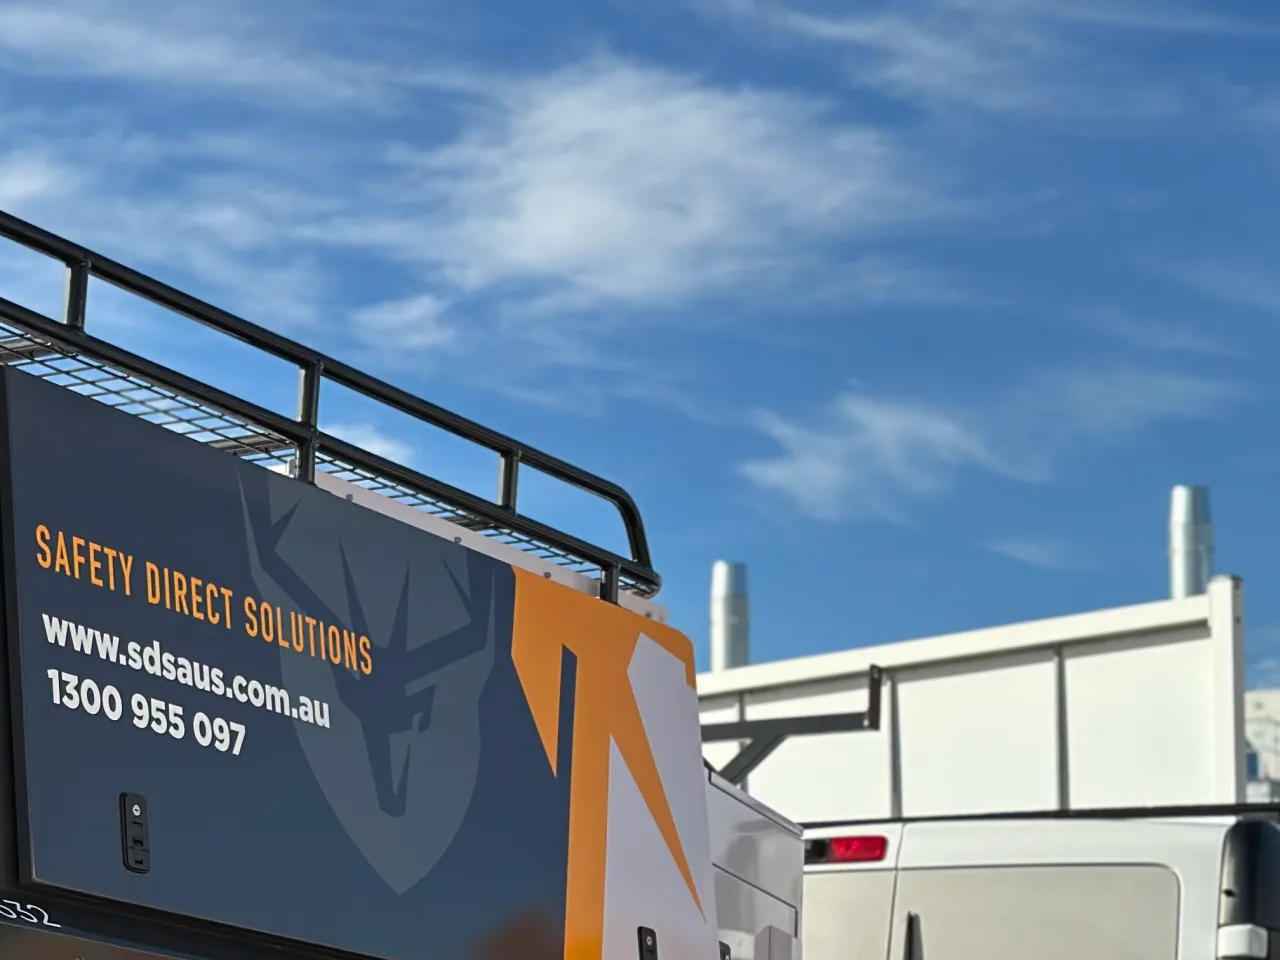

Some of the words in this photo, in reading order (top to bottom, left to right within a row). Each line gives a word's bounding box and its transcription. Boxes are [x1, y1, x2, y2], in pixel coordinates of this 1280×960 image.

[35, 524, 133, 596] SAFETY
[145, 561, 233, 629] DIRECT
[243, 596, 373, 675] SOLUTIONS
[42, 613, 331, 729] www.sdsaus.com.au
[47, 668, 123, 721] 1300
[131, 693, 185, 739] 955
[193, 711, 246, 756] 097
